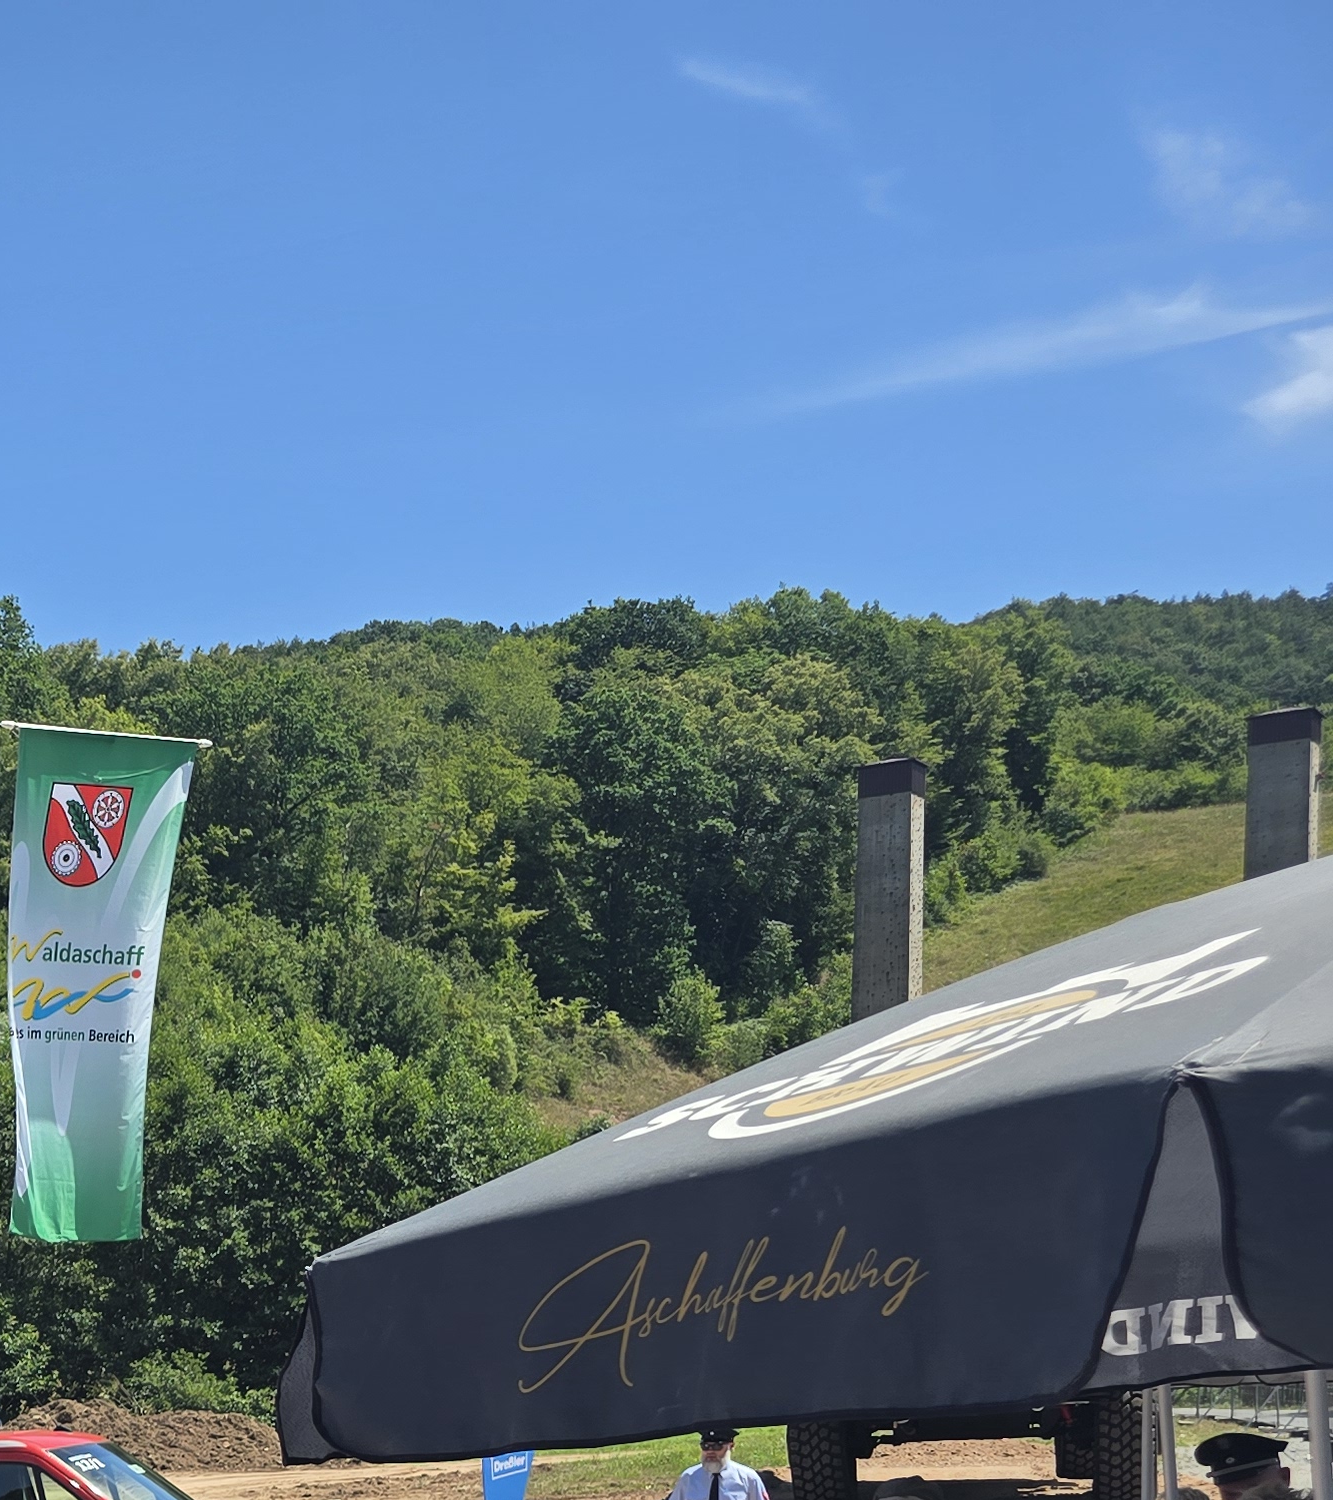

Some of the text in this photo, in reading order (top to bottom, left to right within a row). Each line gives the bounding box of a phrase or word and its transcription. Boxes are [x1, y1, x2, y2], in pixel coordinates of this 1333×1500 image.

[11, 929, 145, 966] Waldaschaff
[27, 1026, 41, 1040] im
[44, 1027, 85, 1044] grünen
[88, 1029, 135, 1044] Bereich
[613, 955, 1271, 1143] SCHWIND
[518, 1225, 930, 1394] Aschaffenburg
